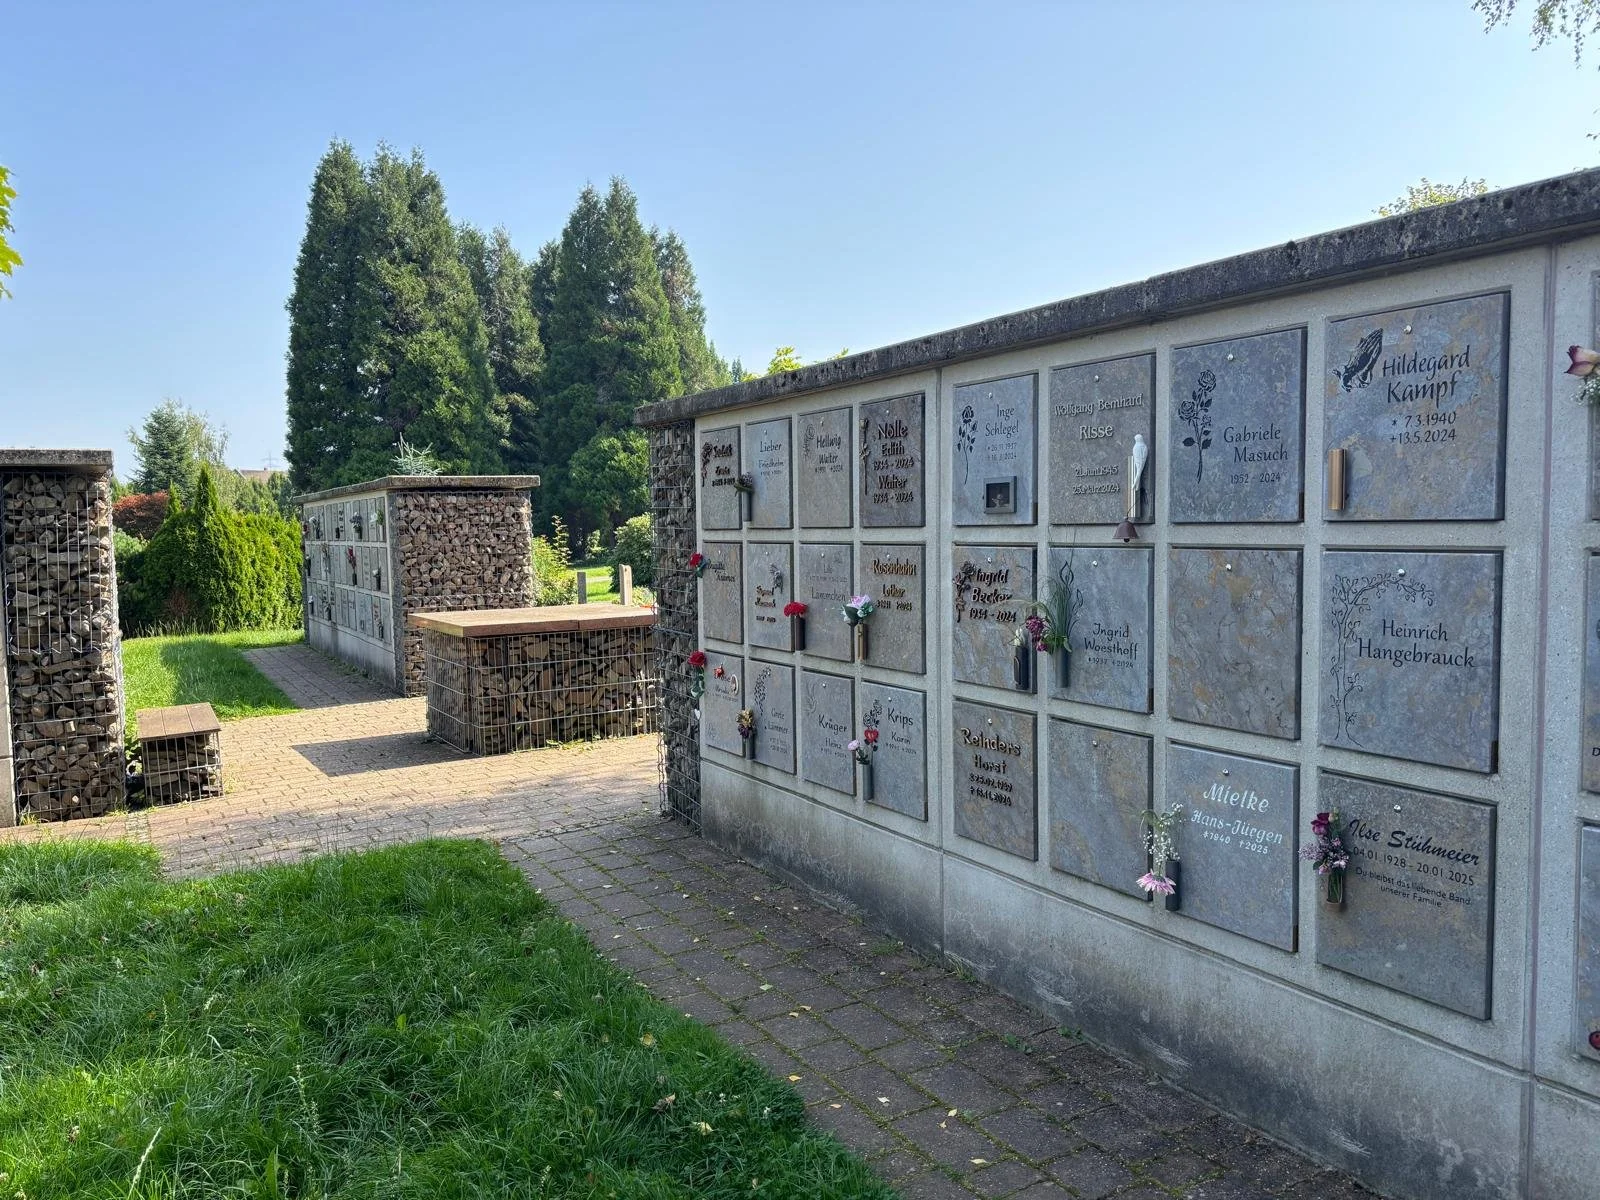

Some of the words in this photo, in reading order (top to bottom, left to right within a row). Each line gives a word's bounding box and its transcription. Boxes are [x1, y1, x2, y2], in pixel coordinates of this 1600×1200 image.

[1382, 345, 1471, 381] Hildegard
[1387, 370, 1463, 409] Kampf
[996, 403, 1015, 421] Inge
[1054, 402, 1095, 418] Wolfgang
[1097, 393, 1145, 412] Bernhard
[985, 419, 1020, 439] Schlegel
[1079, 424, 1115, 441] Risse
[1223, 422, 1282, 444] Gabriele
[759, 439, 783, 453] Lieber
[816, 433, 842, 450] Hellwig
[881, 440, 905, 456] Edith
[1233, 443, 1289, 464] Masuch
[878, 474, 908, 490] Walter
[1259, 471, 1282, 484] 2024
[976, 568, 1010, 587] Ingrid
[971, 587, 1013, 604] Becker
[995, 609, 1018, 623] 2024
[1382, 618, 1448, 642] Heinrich
[1084, 637, 1139, 661] Woesthoff
[1358, 637, 1476, 668] Hangebrauck
[818, 714, 848, 736] Krüger
[887, 707, 914, 730] Krips
[825, 737, 842, 750] Heinz
[891, 731, 912, 745] Karin
[960, 727, 1022, 757] Reinders
[972, 753, 1008, 775] Horst
[1203, 782, 1270, 813] Mielke
[1190, 809, 1283, 845] Hans-Jürgen
[1349, 818, 1381, 842] Ilse
[1387, 830, 1480, 866] Stühmeier
[1355, 866, 1367, 877] Du
[1369, 871, 1394, 885] bleibst
[1396, 877, 1410, 889] das
[1411, 881, 1447, 899] liebende
[1448, 892, 1471, 906] Band
[1380, 885, 1410, 898] unserer
[1413, 892, 1442, 908] Familie
